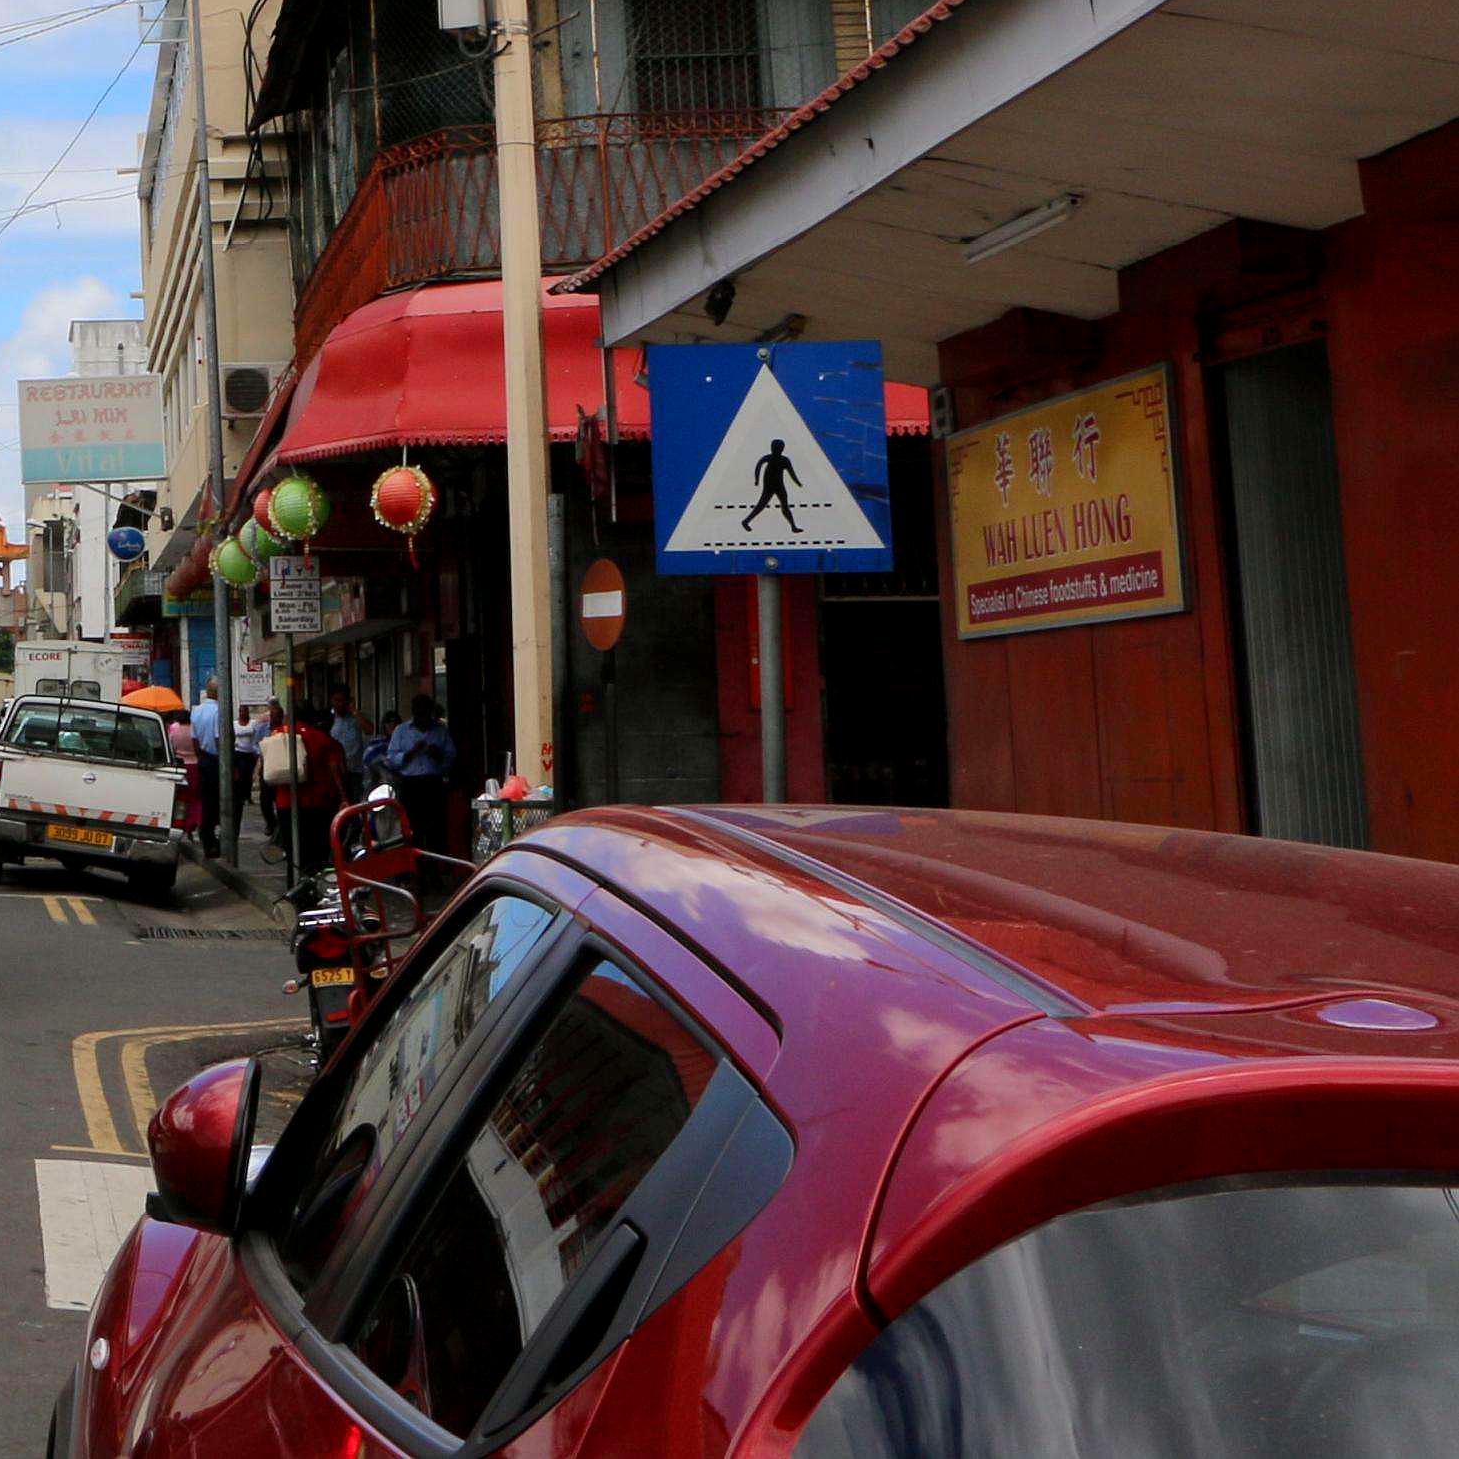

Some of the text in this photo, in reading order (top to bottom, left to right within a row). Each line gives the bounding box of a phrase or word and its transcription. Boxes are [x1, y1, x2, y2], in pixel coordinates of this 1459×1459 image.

[26, 381, 155, 402] RESTAURANT
[983, 494, 1134, 567] WAH LUEN HONG
[970, 565, 1158, 618] Specialist in Chinese foodstuffs & medicine
[277, 615, 315, 623] Saturday
[54, 826, 78, 840] 3099
